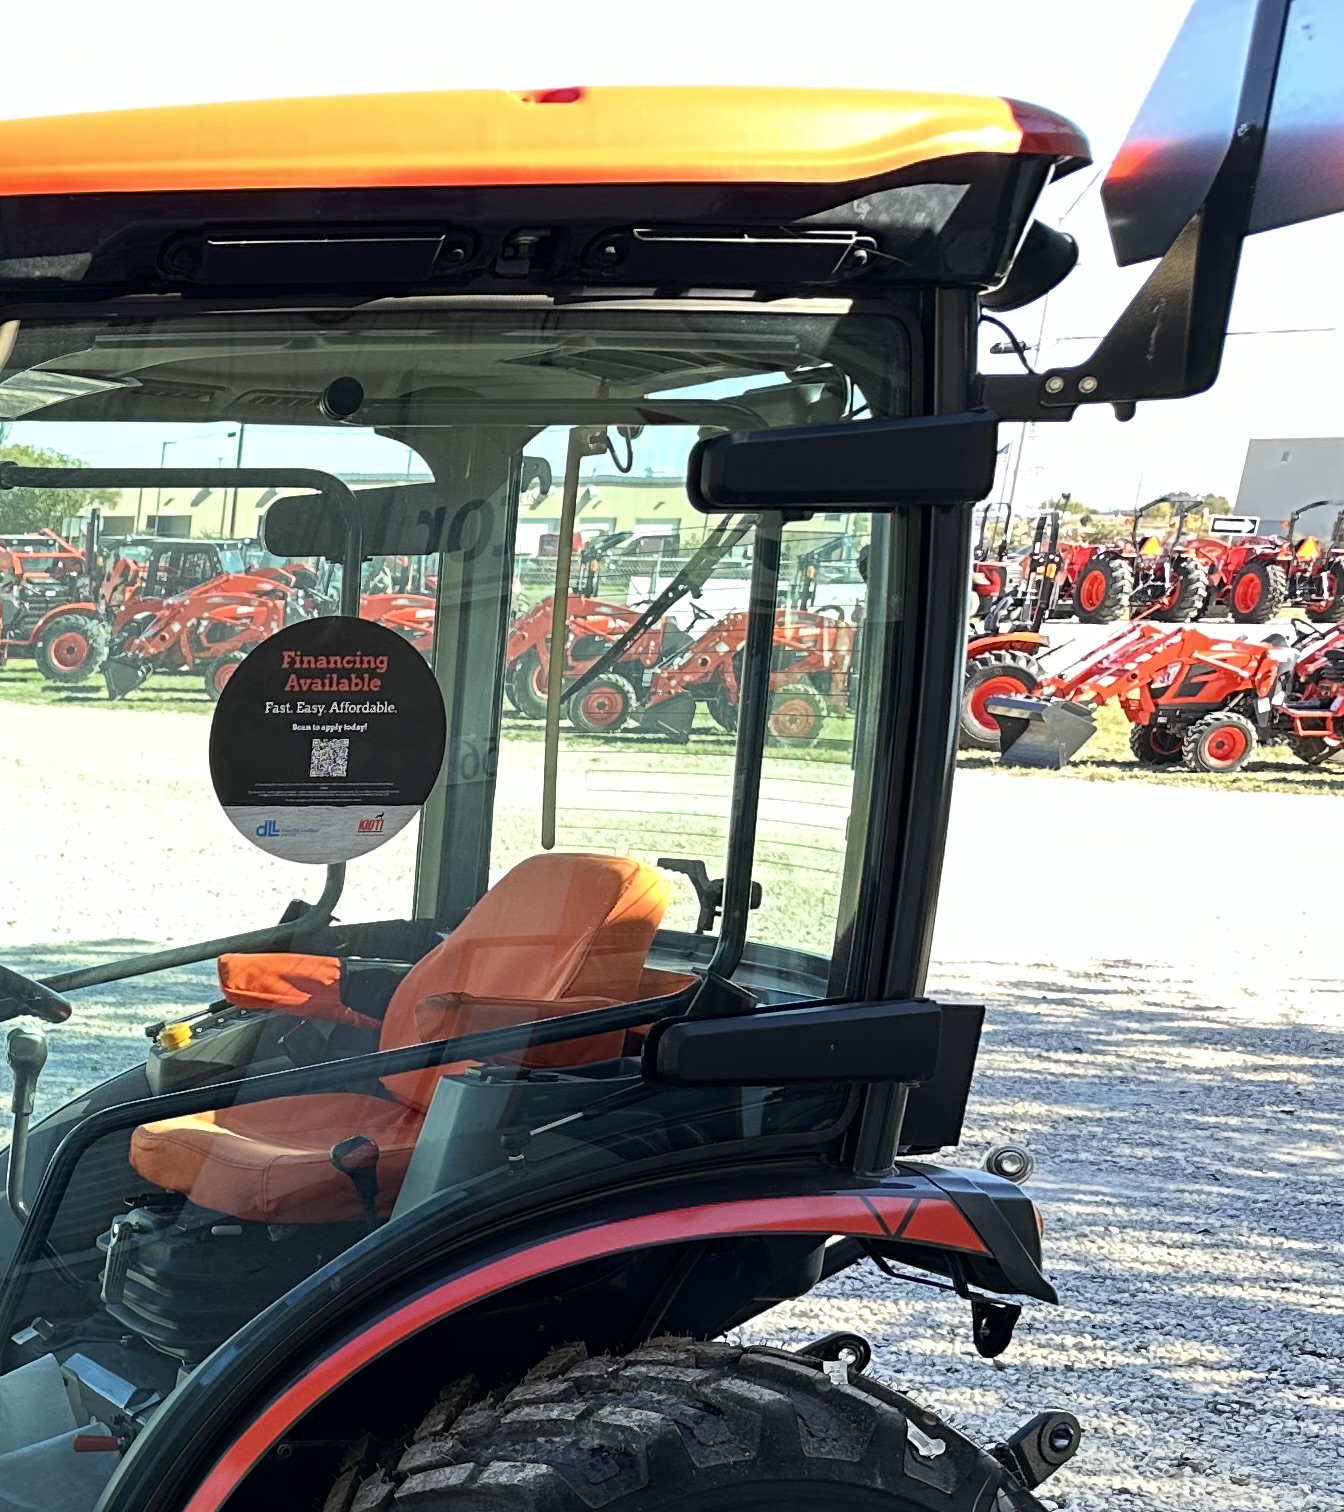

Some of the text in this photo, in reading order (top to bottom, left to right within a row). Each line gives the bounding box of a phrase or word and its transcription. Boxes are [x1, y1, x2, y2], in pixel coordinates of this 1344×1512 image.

[281, 651, 389, 672] Financing
[284, 674, 382, 691] Available
[265, 701, 398, 716] Fast. Easy. Affordable.
[292, 723, 368, 733] Scan to apply today!
[358, 819, 385, 832] KIOTI
